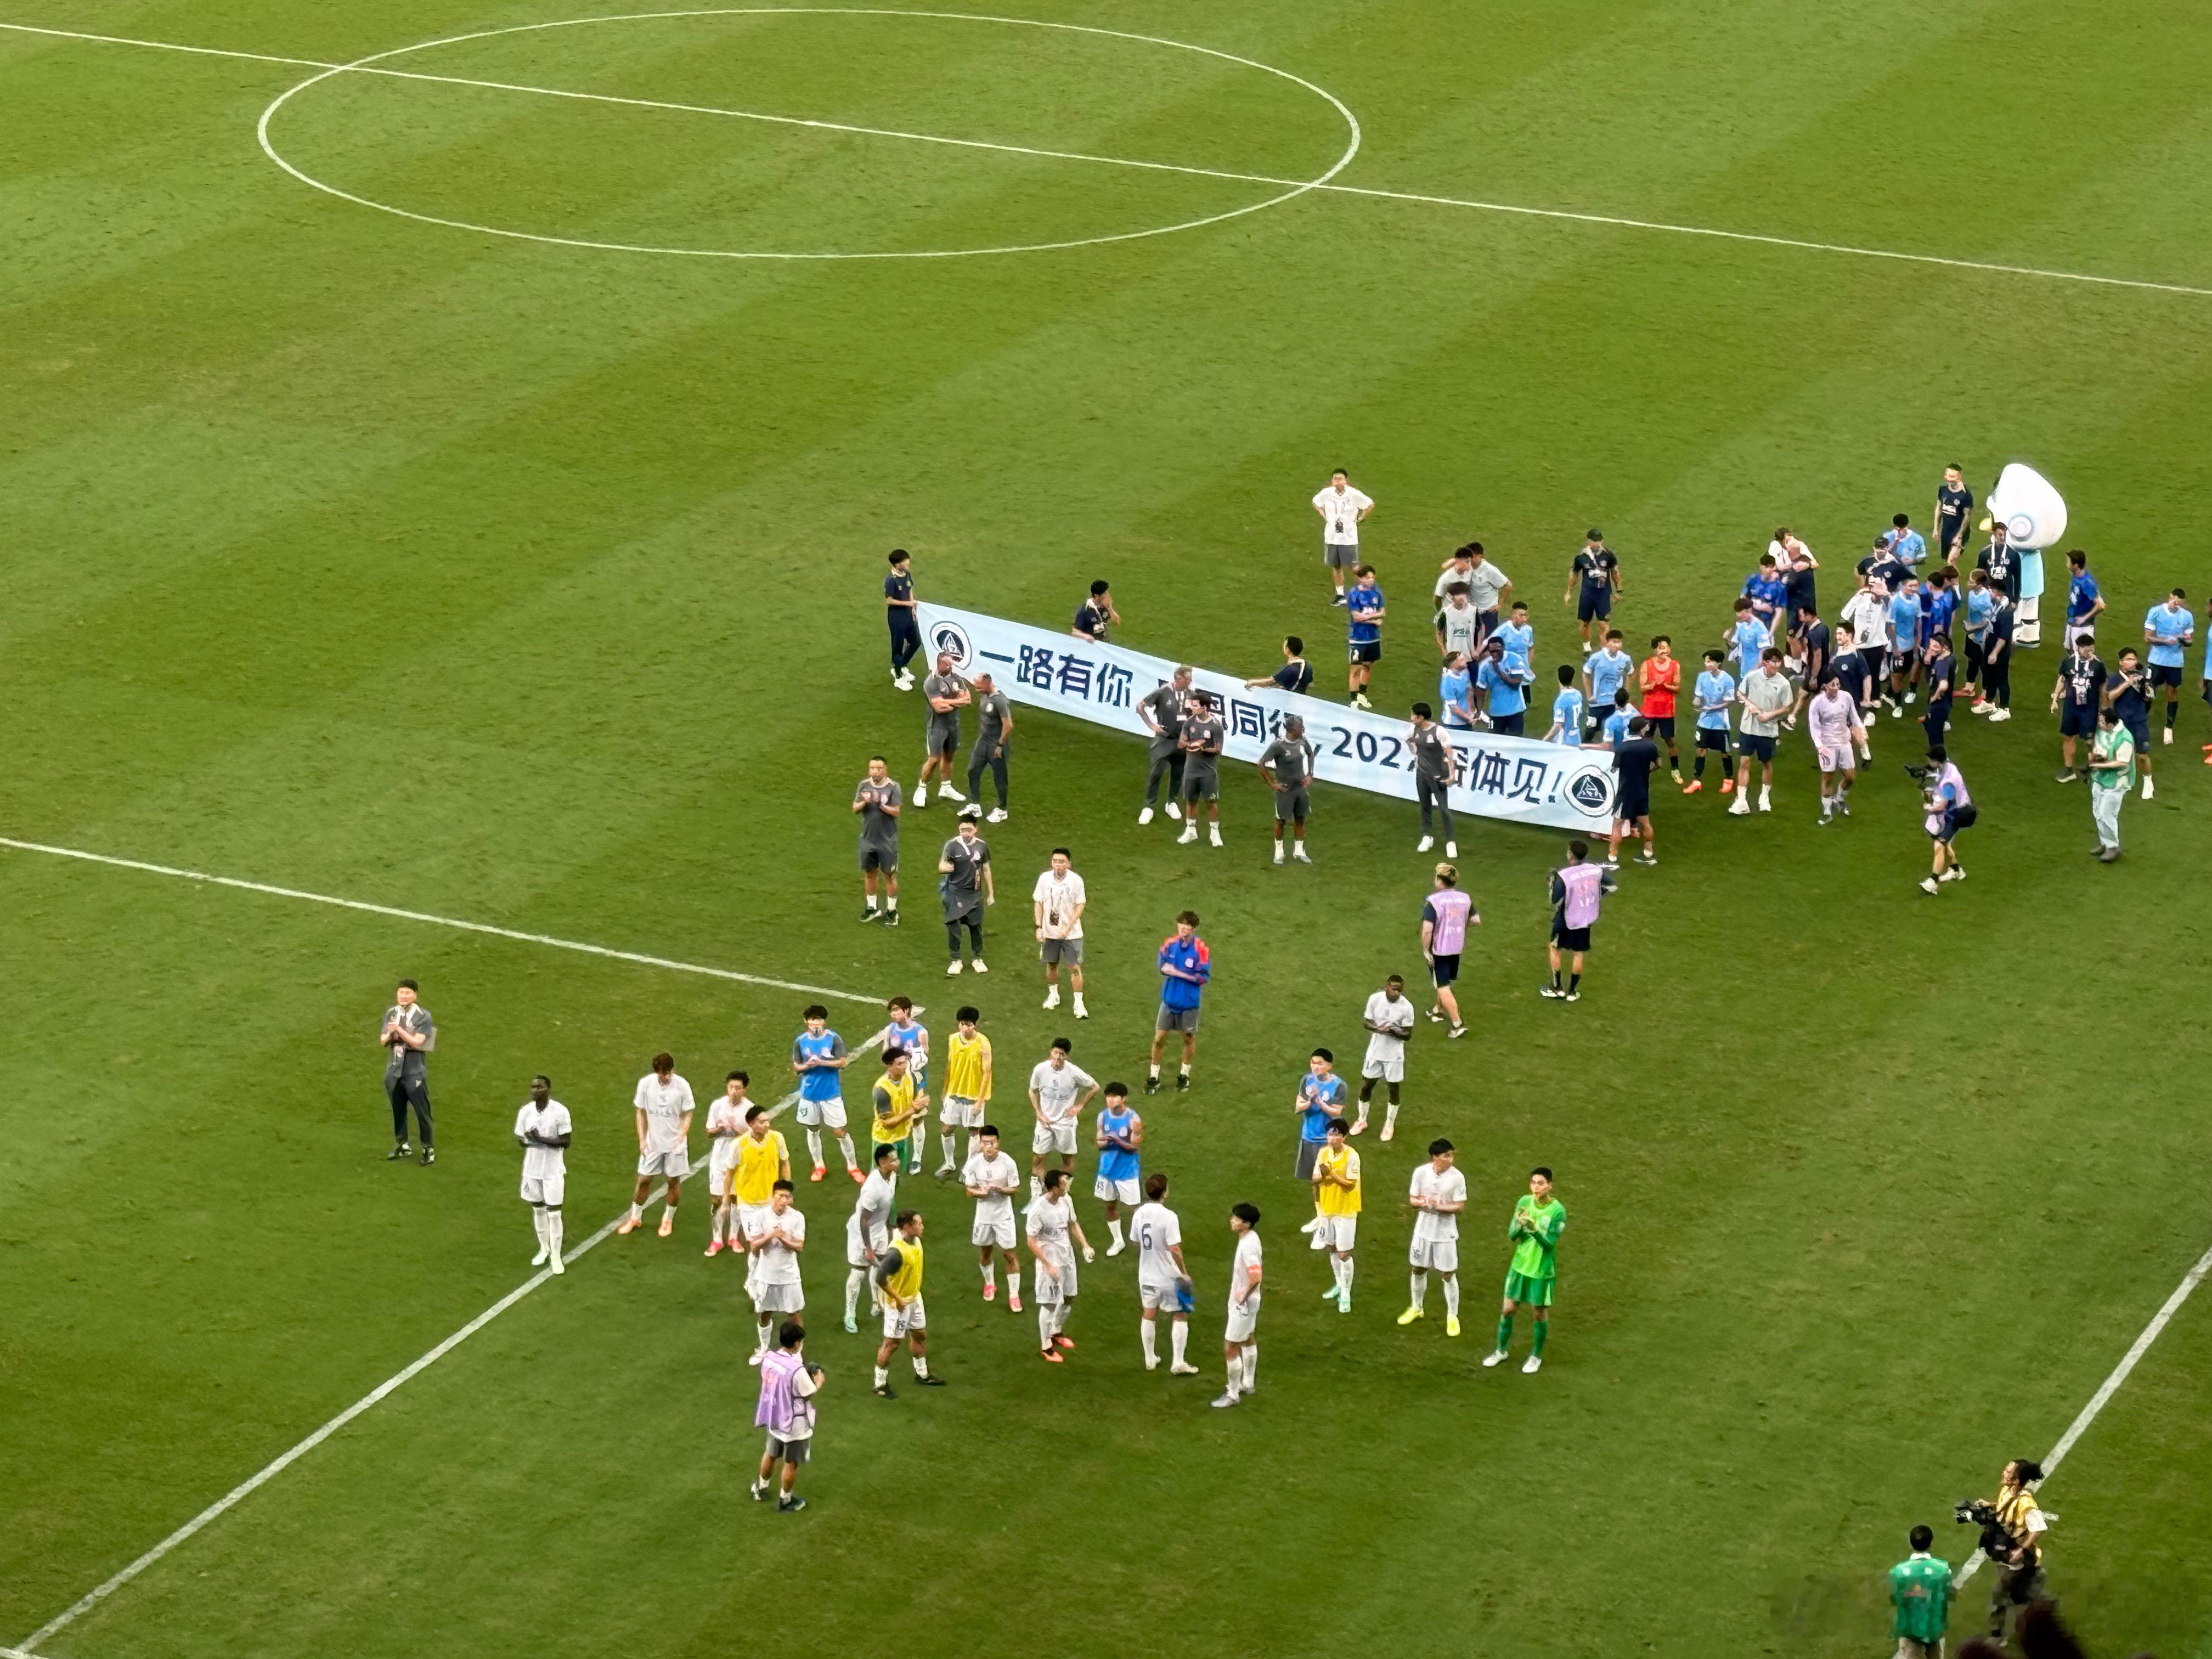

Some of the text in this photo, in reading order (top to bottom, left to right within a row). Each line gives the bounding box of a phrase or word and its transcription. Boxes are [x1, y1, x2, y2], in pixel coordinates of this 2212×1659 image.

[979, 644, 1133, 708] 一路有你
[1142, 1223, 1153, 1250] 6
